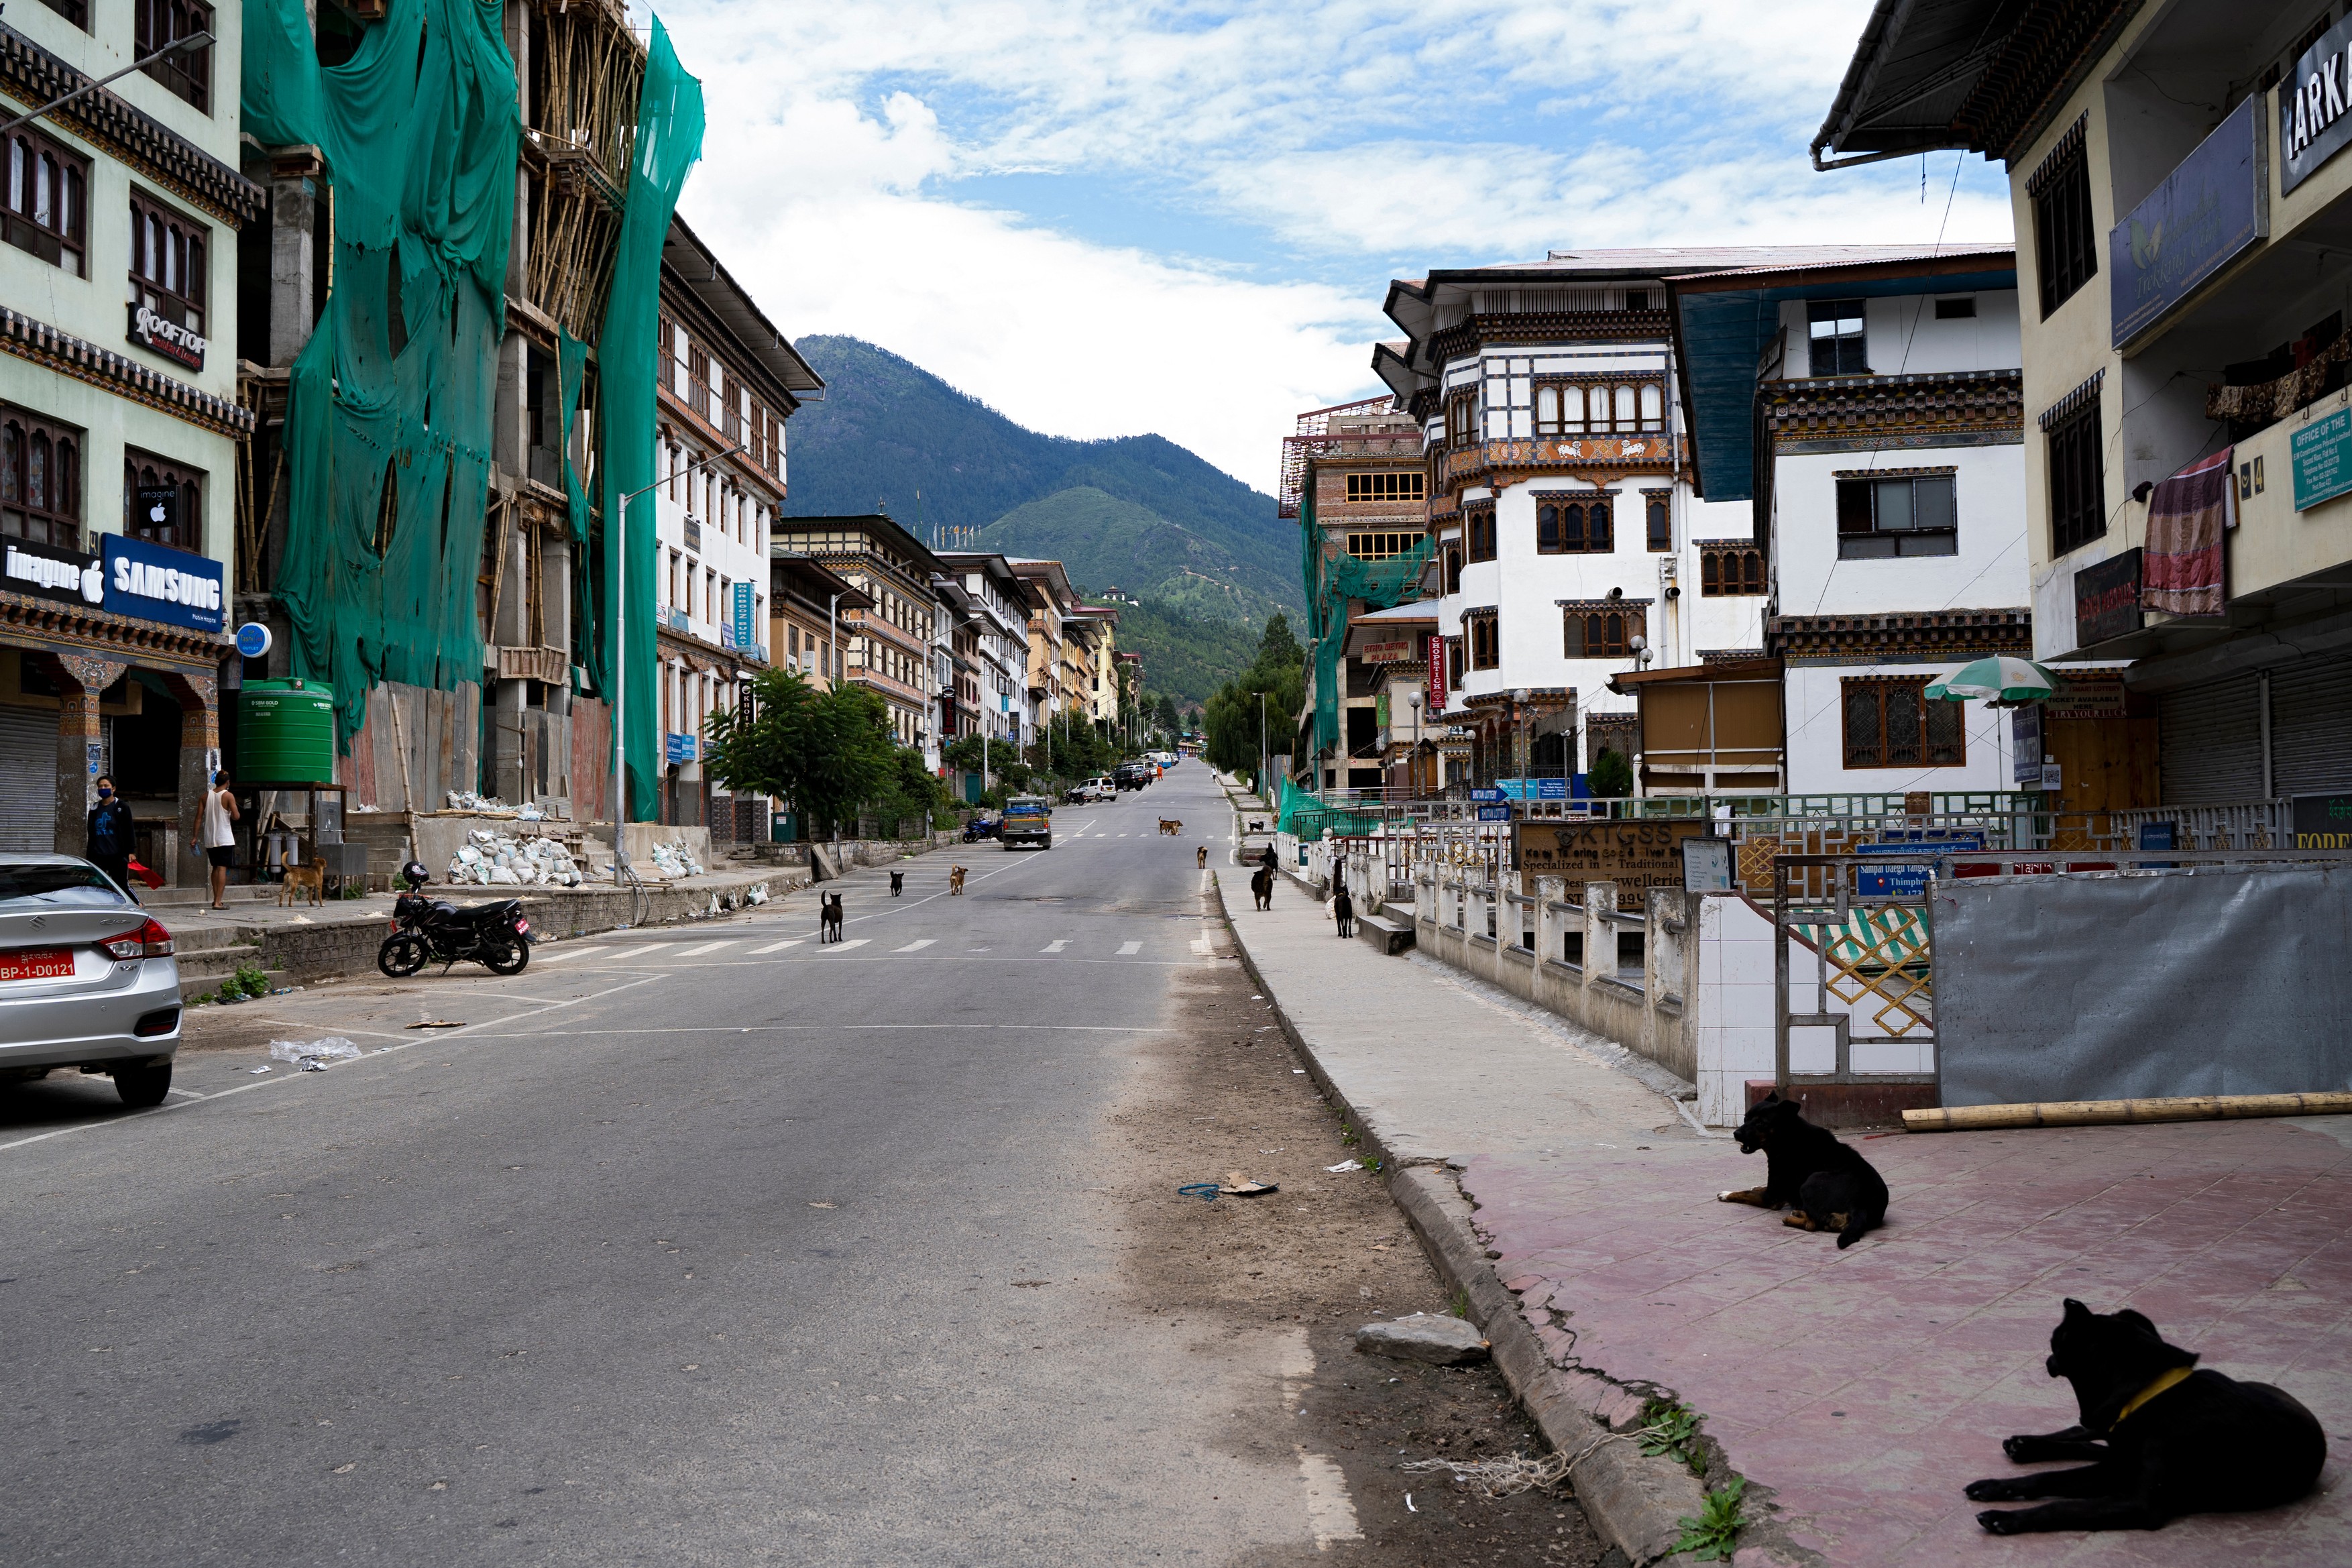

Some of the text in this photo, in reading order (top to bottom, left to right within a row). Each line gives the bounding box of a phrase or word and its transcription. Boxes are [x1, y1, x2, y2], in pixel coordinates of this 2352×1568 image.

[2282, 40, 2352, 160] YARK
[2135, 247, 2186, 300] Trekking
[136, 307, 207, 354] ROOFTOP
[2296, 414, 2346, 447] OFFICE OF THE
[2300, 443, 2322, 458] Construction
[2322, 437, 2335, 449] Private
[2336, 429, 2351, 443] Limited
[2255, 458, 2262, 490] 4
[140, 491, 175, 501] imagine
[6, 545, 80, 591] imagine
[113, 557, 220, 610] SAMSUNG
[192, 613, 217, 624] Mobile Hospital
[738, 622, 747, 644] BURAY
[1363, 641, 1408, 653] ETHO METHO
[1371, 653, 1398, 662] PLAZA
[1432, 636, 1441, 689] CHOPSTICK
[2055, 710, 2073, 718] TRY
[2102, 708, 2127, 717] LUCK
[1472, 789, 1484, 799] BHUTAN
[1484, 789, 1498, 799] LOTTERY
[1481, 807, 1507, 820] BHUTAN LOTTERY
[1580, 822, 1673, 846] KTGSS
[2296, 833, 2352, 848] FORE
[1523, 859, 1583, 871] Specialized
[1589, 859, 1600, 869] in
[1617, 858, 1679, 870] Traditional
[1889, 877, 1925, 887] Thimphu
[1, 963, 74, 979] BP-1-D0121
